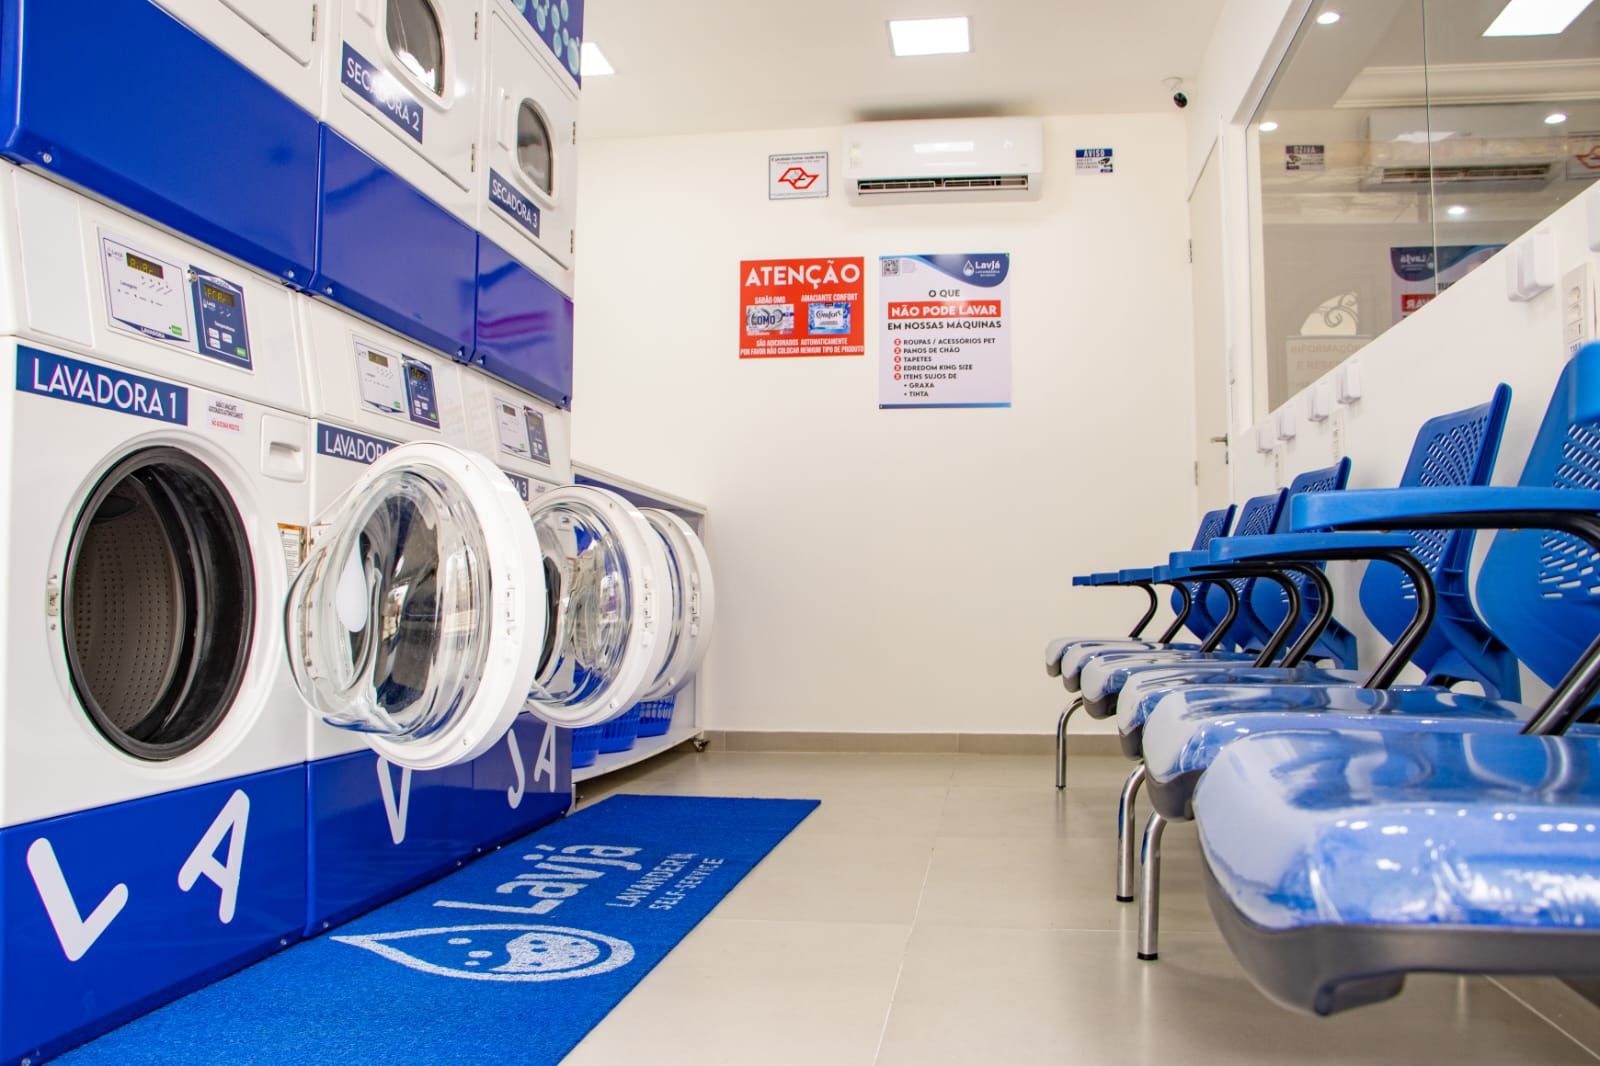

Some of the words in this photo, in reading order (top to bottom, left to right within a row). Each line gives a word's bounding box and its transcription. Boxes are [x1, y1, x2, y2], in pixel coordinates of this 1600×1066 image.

[346, 57, 410, 124] SECORA
[412, 112, 420, 132] 2
[1084, 149, 1104, 157] AVISO
[492, 179, 532, 224] SECADORA
[532, 212, 538, 228] 3
[745, 260, 860, 290] ATENÇÃO
[975, 260, 1000, 270] Lavjá
[928, 290, 936, 298] O
[940, 289, 960, 298] QUE
[888, 322, 902, 330] EM
[904, 321, 944, 330] NOSSAS
[891, 304, 920, 317] NÃO
[922, 306, 956, 316] PODE
[959, 304, 997, 315] LAVAR
[33, 358, 164, 417] LAVADORA
[170, 392, 176, 419] 1
[325, 430, 390, 462] LAVADOR
[522, 480, 527, 498] 3
[26, 837, 128, 962] L
[177, 788, 250, 924] A
[507, 728, 526, 809] J
[432, 844, 644, 915] Lavjá
[605, 853, 700, 908] LAVANDERIA
[649, 857, 724, 911] SELF-SERVICE
